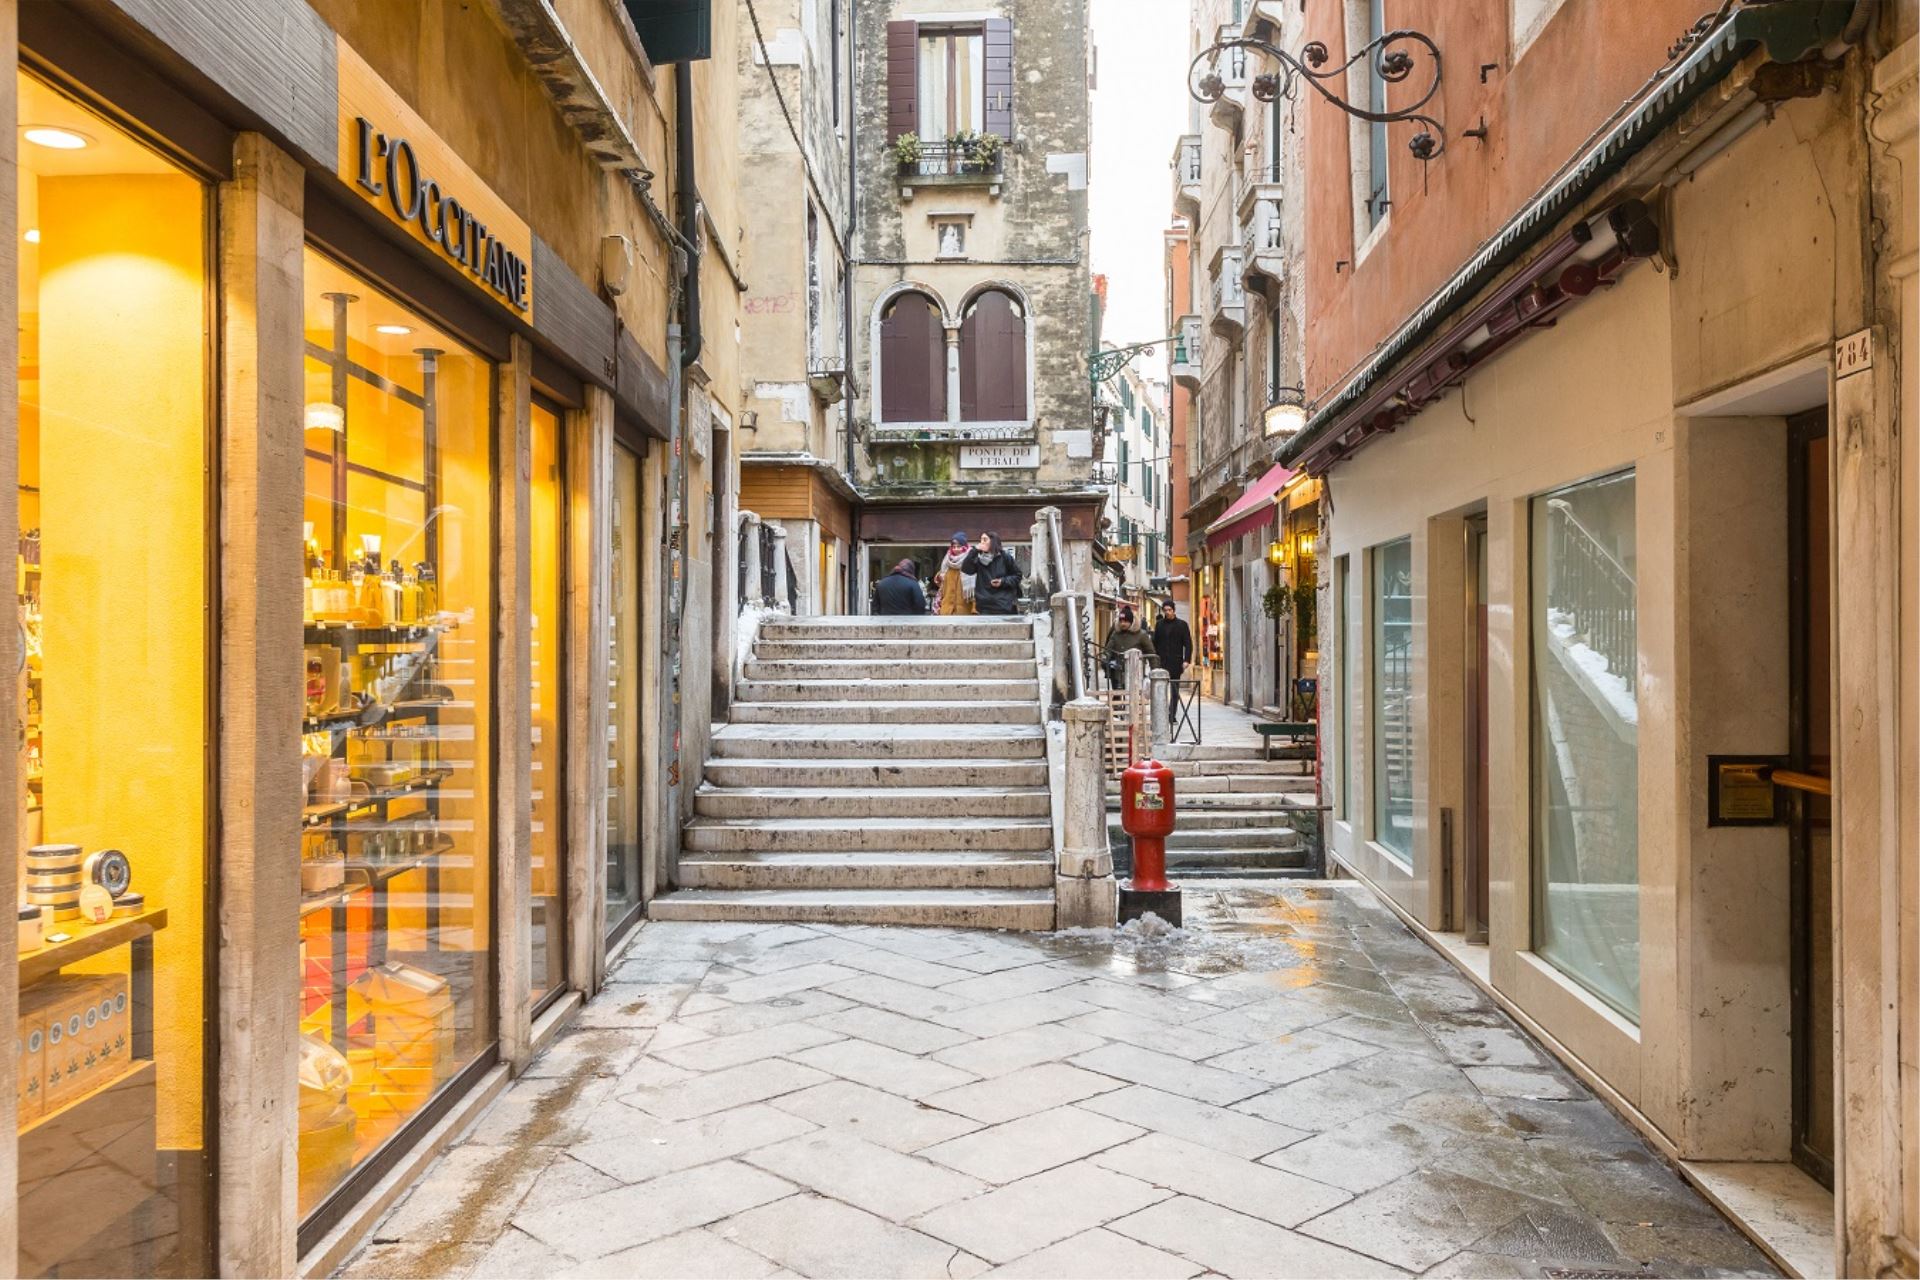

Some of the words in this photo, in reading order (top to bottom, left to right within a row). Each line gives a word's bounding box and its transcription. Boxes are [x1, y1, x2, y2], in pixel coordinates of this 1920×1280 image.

[355, 117, 528, 312] L'OCCITANE
[1836, 336, 1868, 370] 784
[968, 448, 1006, 456] PONTE
[1012, 448, 1031, 456] DEI
